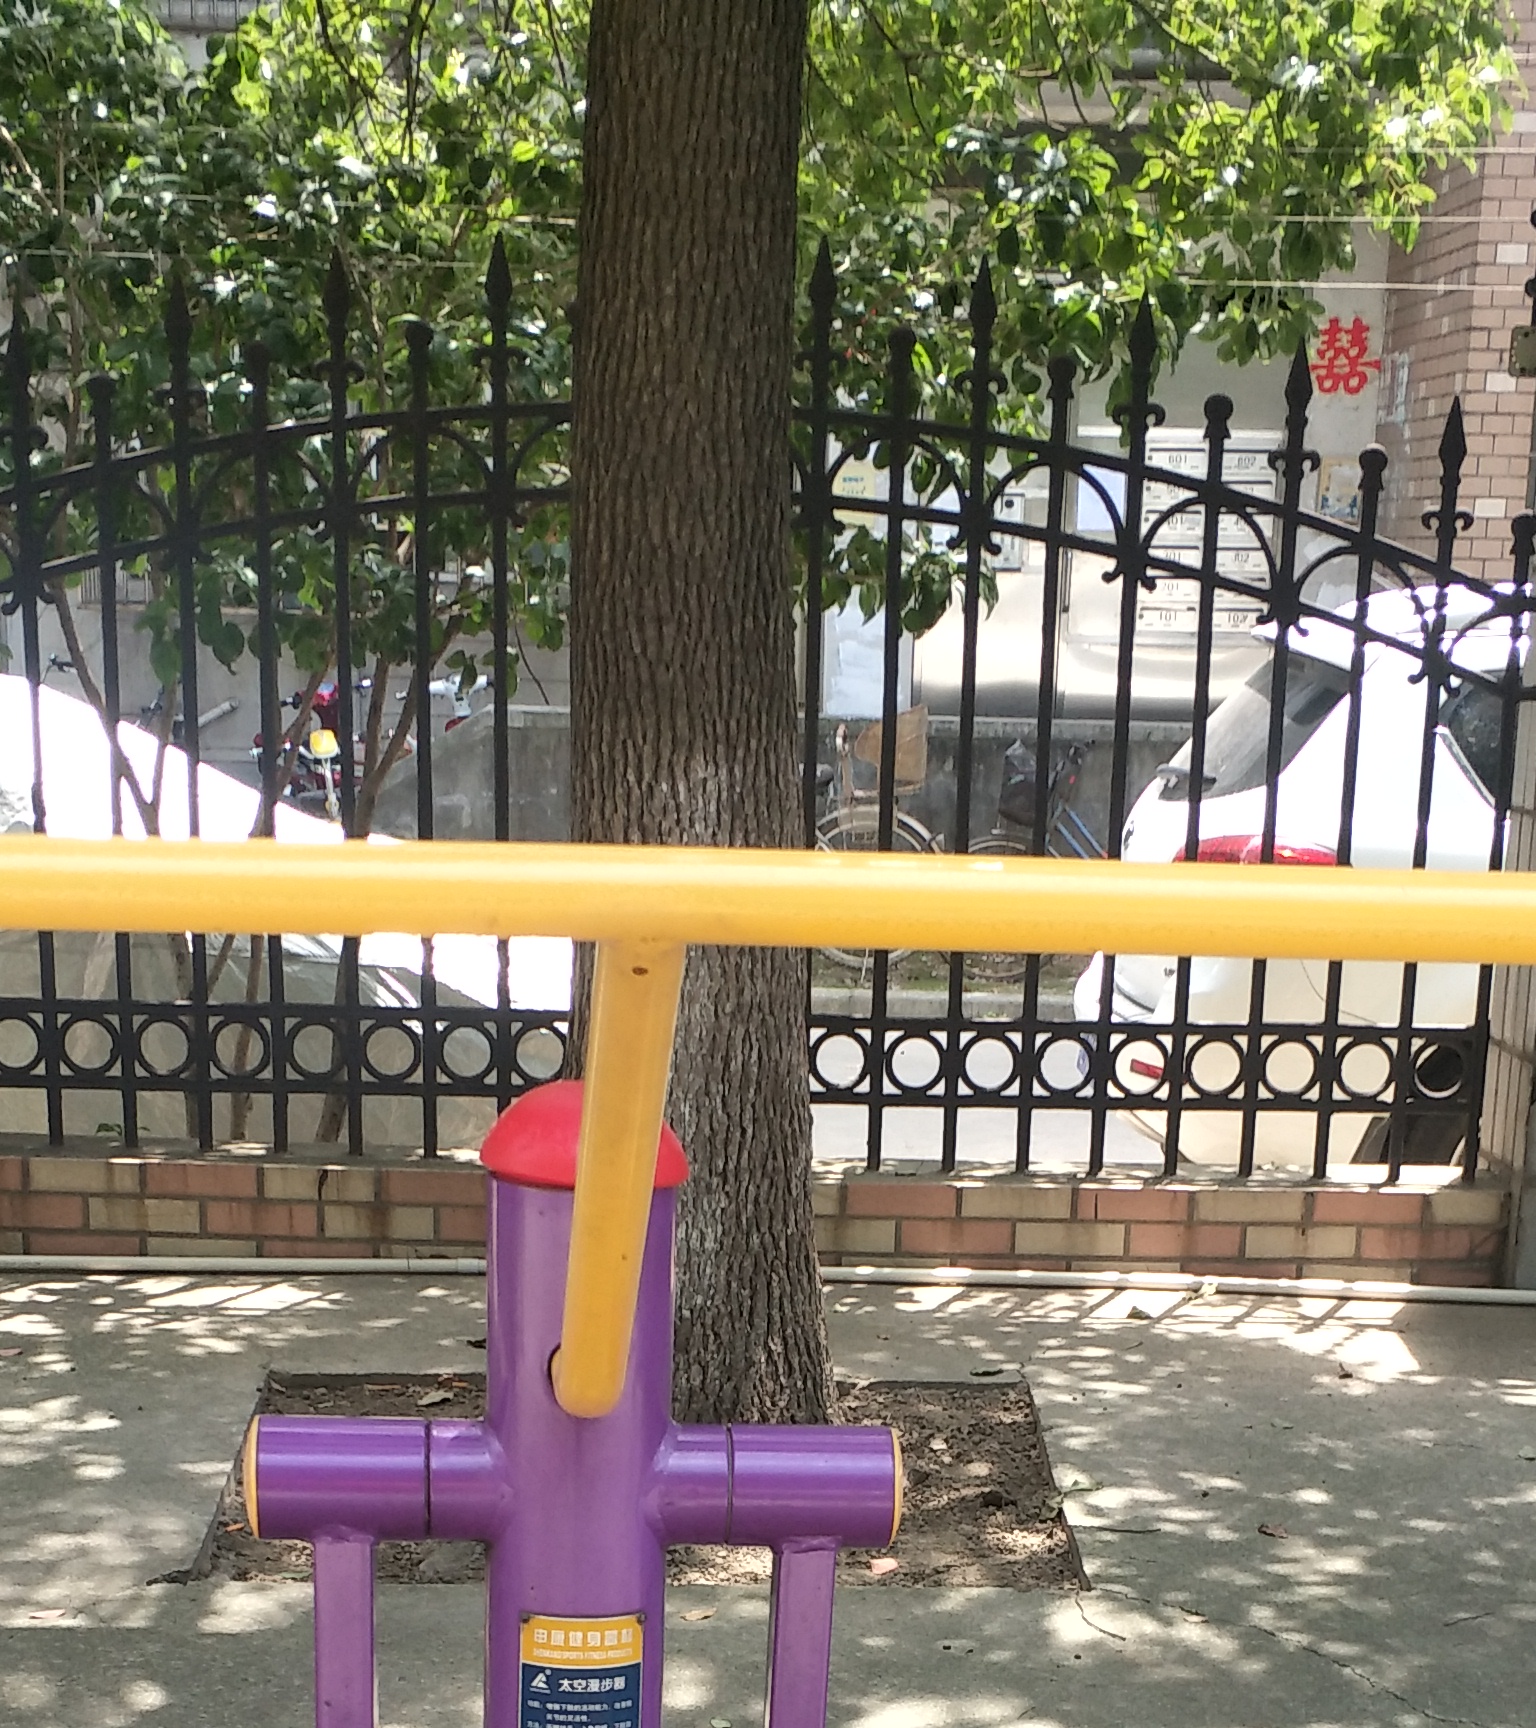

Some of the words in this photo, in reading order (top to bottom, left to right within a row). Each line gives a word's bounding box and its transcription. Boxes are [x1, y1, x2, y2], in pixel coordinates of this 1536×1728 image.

[1168, 454, 1188, 464] 601
[1237, 455, 1257, 467] 602
[1159, 611, 1177, 622] 101
